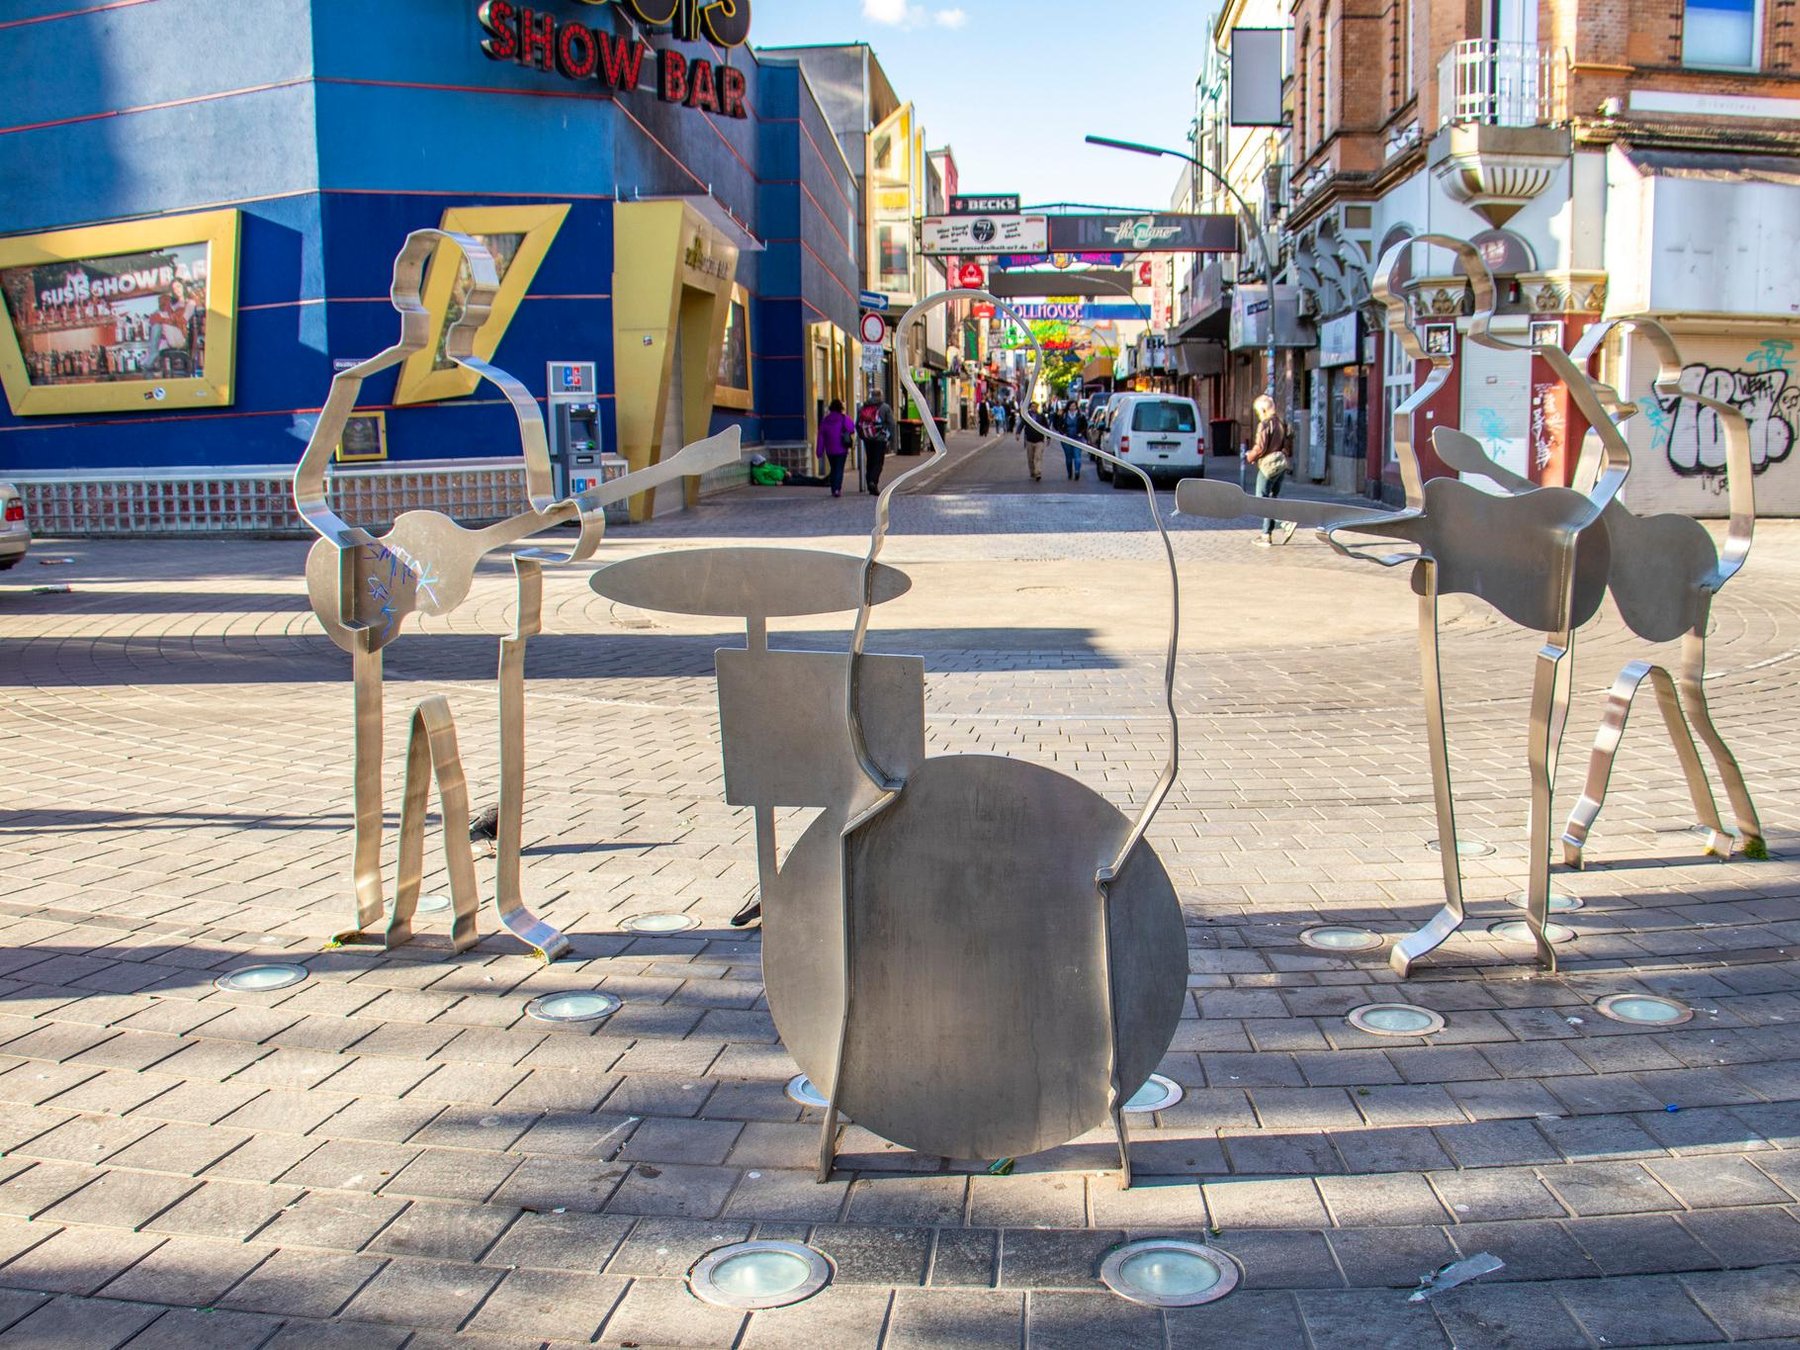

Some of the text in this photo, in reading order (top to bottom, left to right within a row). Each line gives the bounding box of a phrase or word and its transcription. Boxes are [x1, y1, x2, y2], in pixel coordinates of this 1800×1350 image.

[479, 0, 645, 92] SHOW
[659, 48, 747, 119] BAR
[968, 198, 1016, 210] BECK'S
